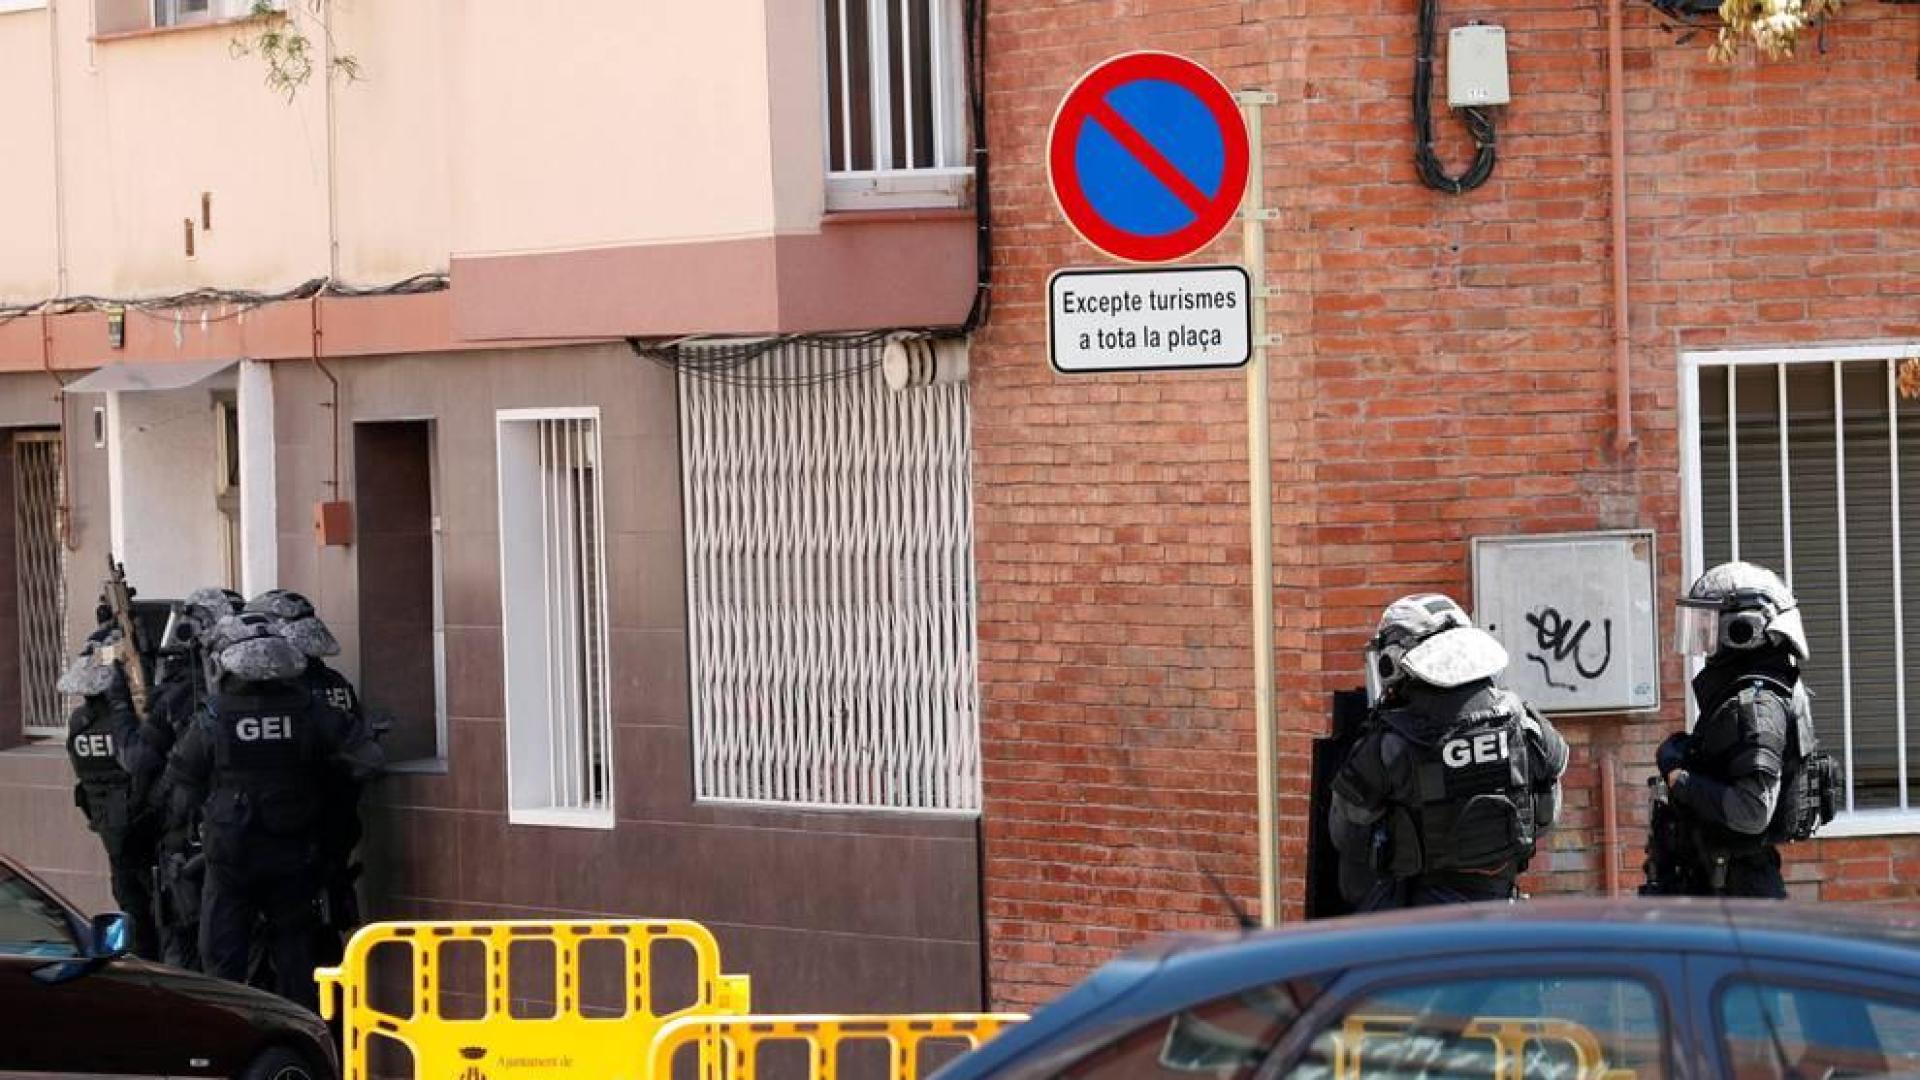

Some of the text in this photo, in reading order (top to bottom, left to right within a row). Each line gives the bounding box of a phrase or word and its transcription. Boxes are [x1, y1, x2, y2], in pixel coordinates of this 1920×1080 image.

[1062, 287, 1237, 316] Excepte turismes
[1079, 324, 1222, 352] a tota la plaça
[235, 715, 292, 742] GEI
[73, 734, 114, 757] GEI
[1442, 730, 1509, 769] GEI
